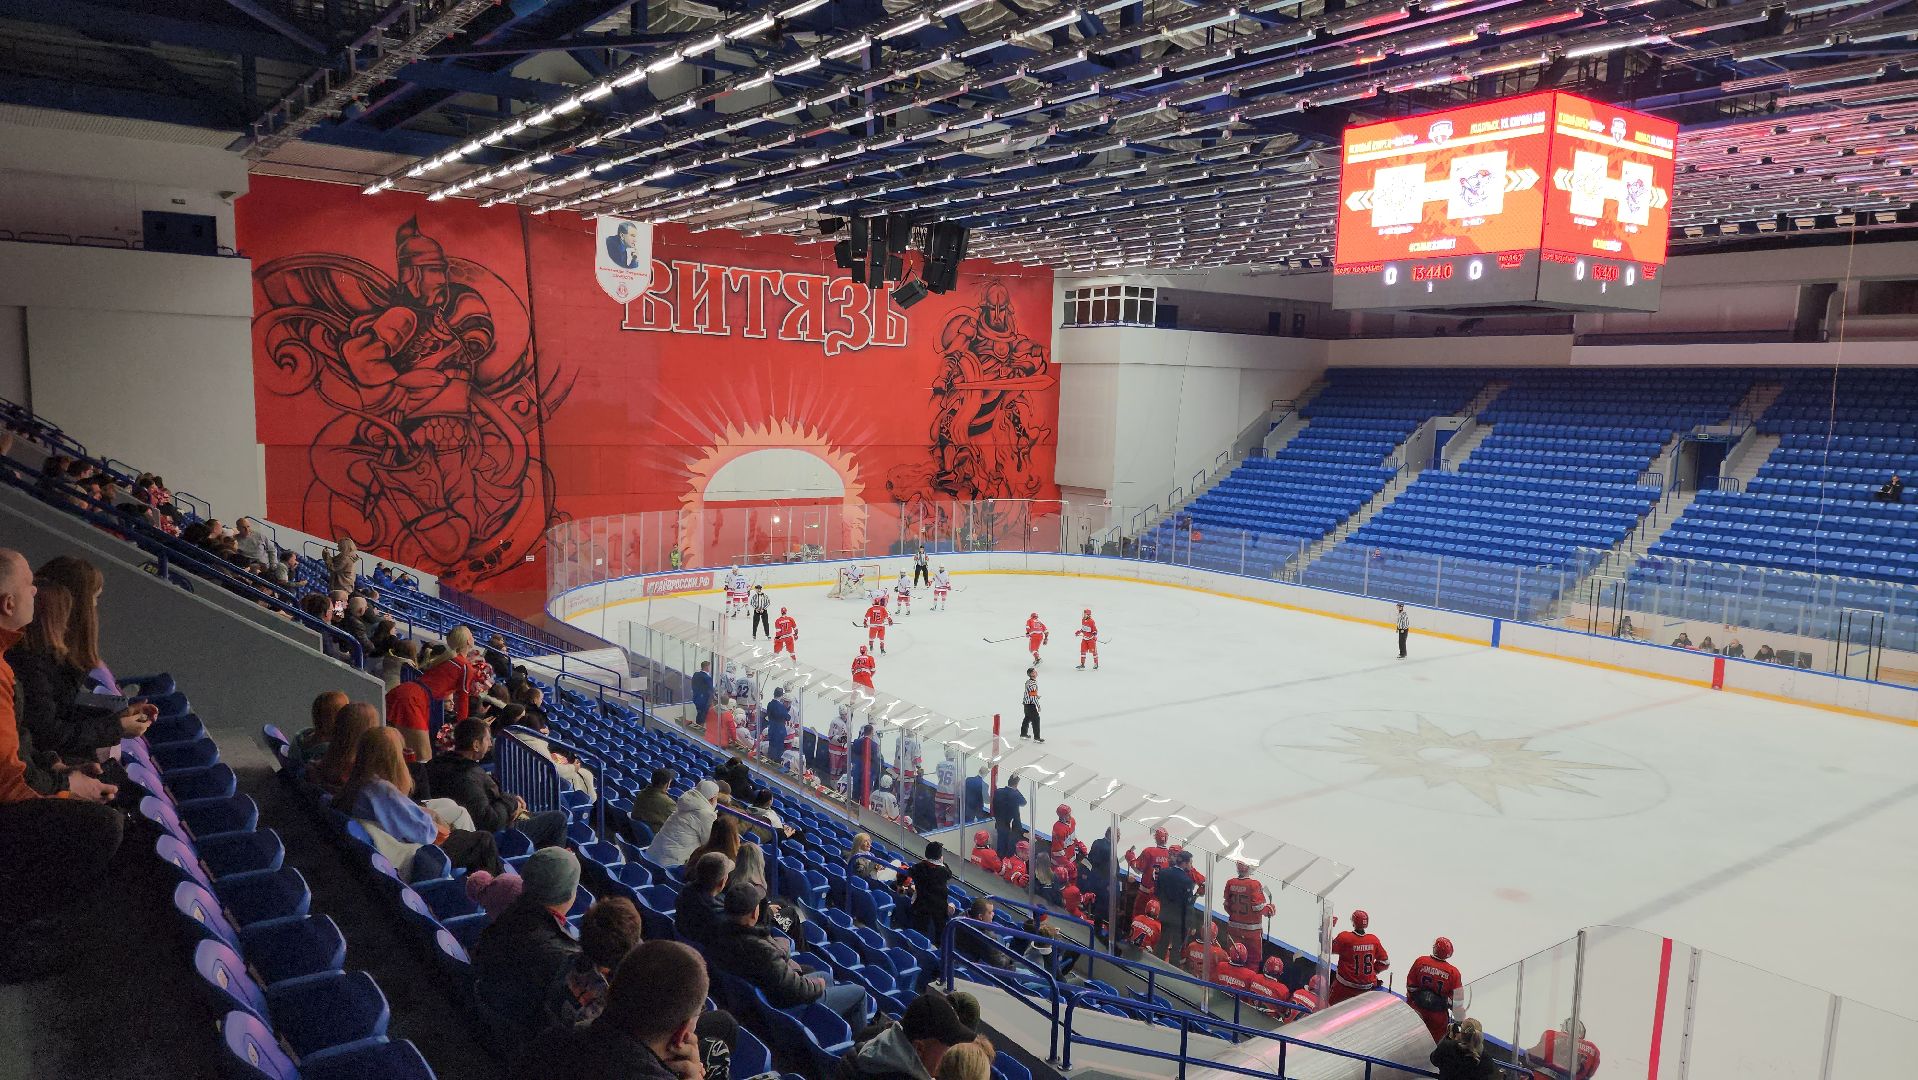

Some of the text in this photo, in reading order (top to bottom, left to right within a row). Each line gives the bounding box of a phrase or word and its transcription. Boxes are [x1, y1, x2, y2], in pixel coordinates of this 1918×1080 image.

[1385, 267, 1397, 285] 0
[1470, 260, 1483, 280] 0
[1577, 261, 1585, 281] 0
[1626, 267, 1635, 286] 0
[621, 259, 909, 356] ВИТЯЗЬ
[736, 581, 746, 590] 27
[737, 685, 749, 699] 22
